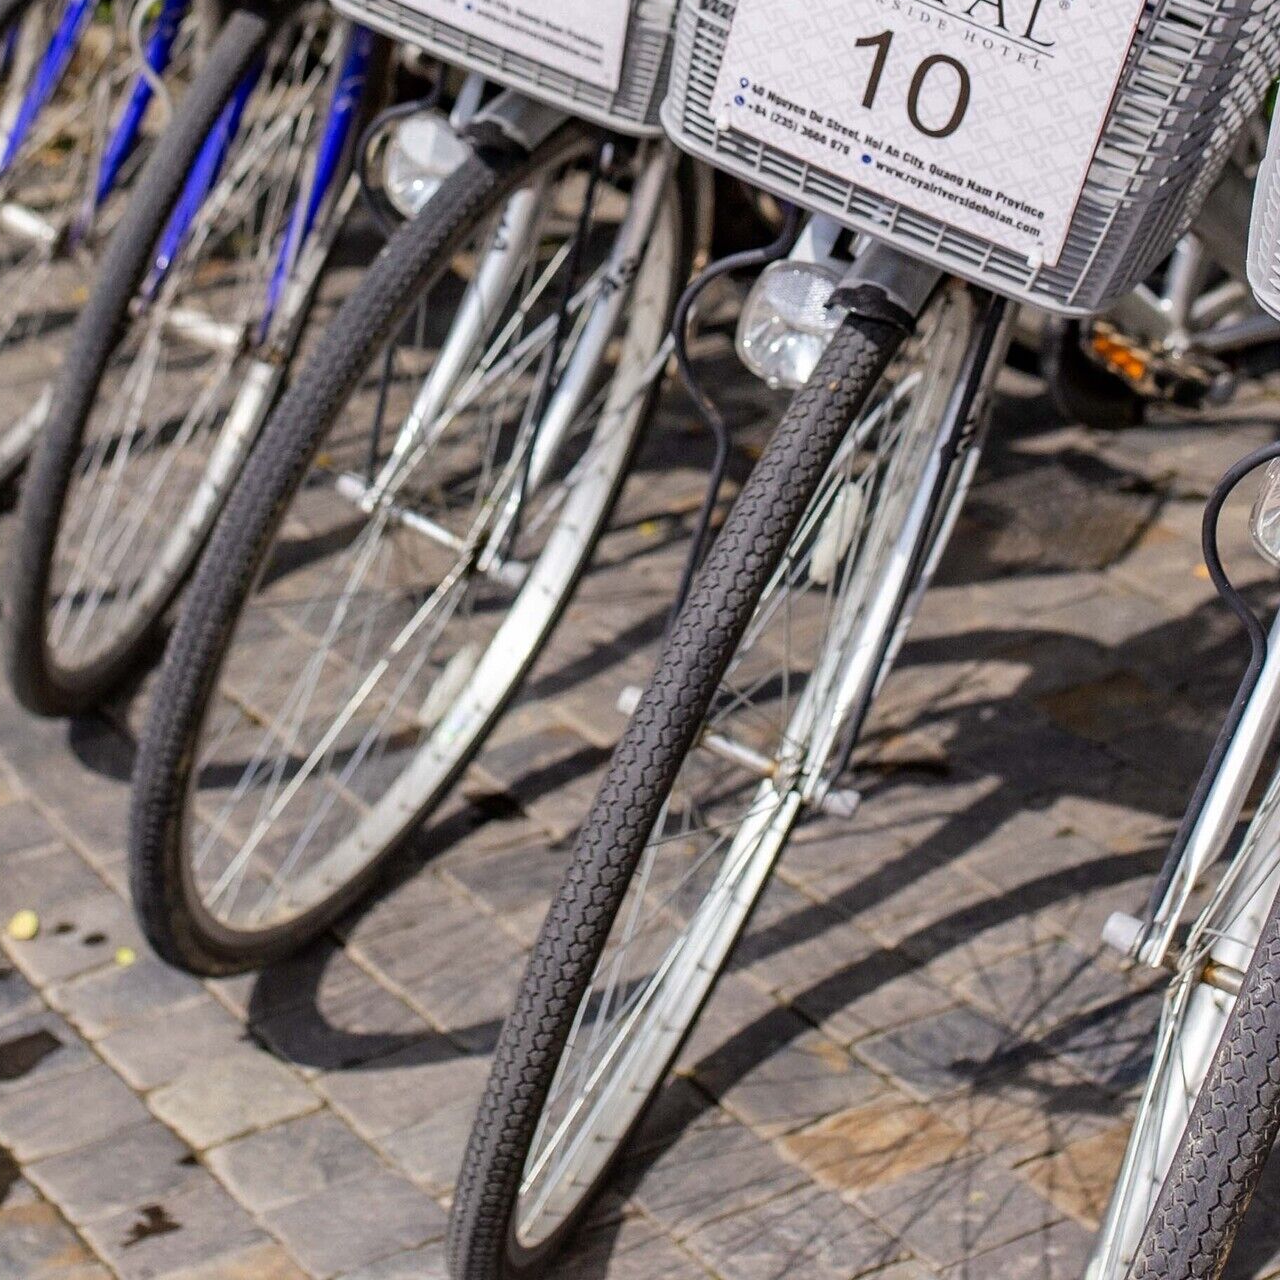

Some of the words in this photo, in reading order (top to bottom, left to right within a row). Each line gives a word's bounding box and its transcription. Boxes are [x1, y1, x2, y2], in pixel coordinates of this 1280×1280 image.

[853, 29, 972, 139] 10
[964, 28, 1042, 71] HOTEL
[767, 90, 807, 116] Nguyen
[809, 110, 823, 124] Du
[885, 144, 900, 158] An
[966, 178, 993, 198] Nam
[995, 190, 1045, 220] Province
[875, 160, 1041, 237] www.royalriversidehoian.com
